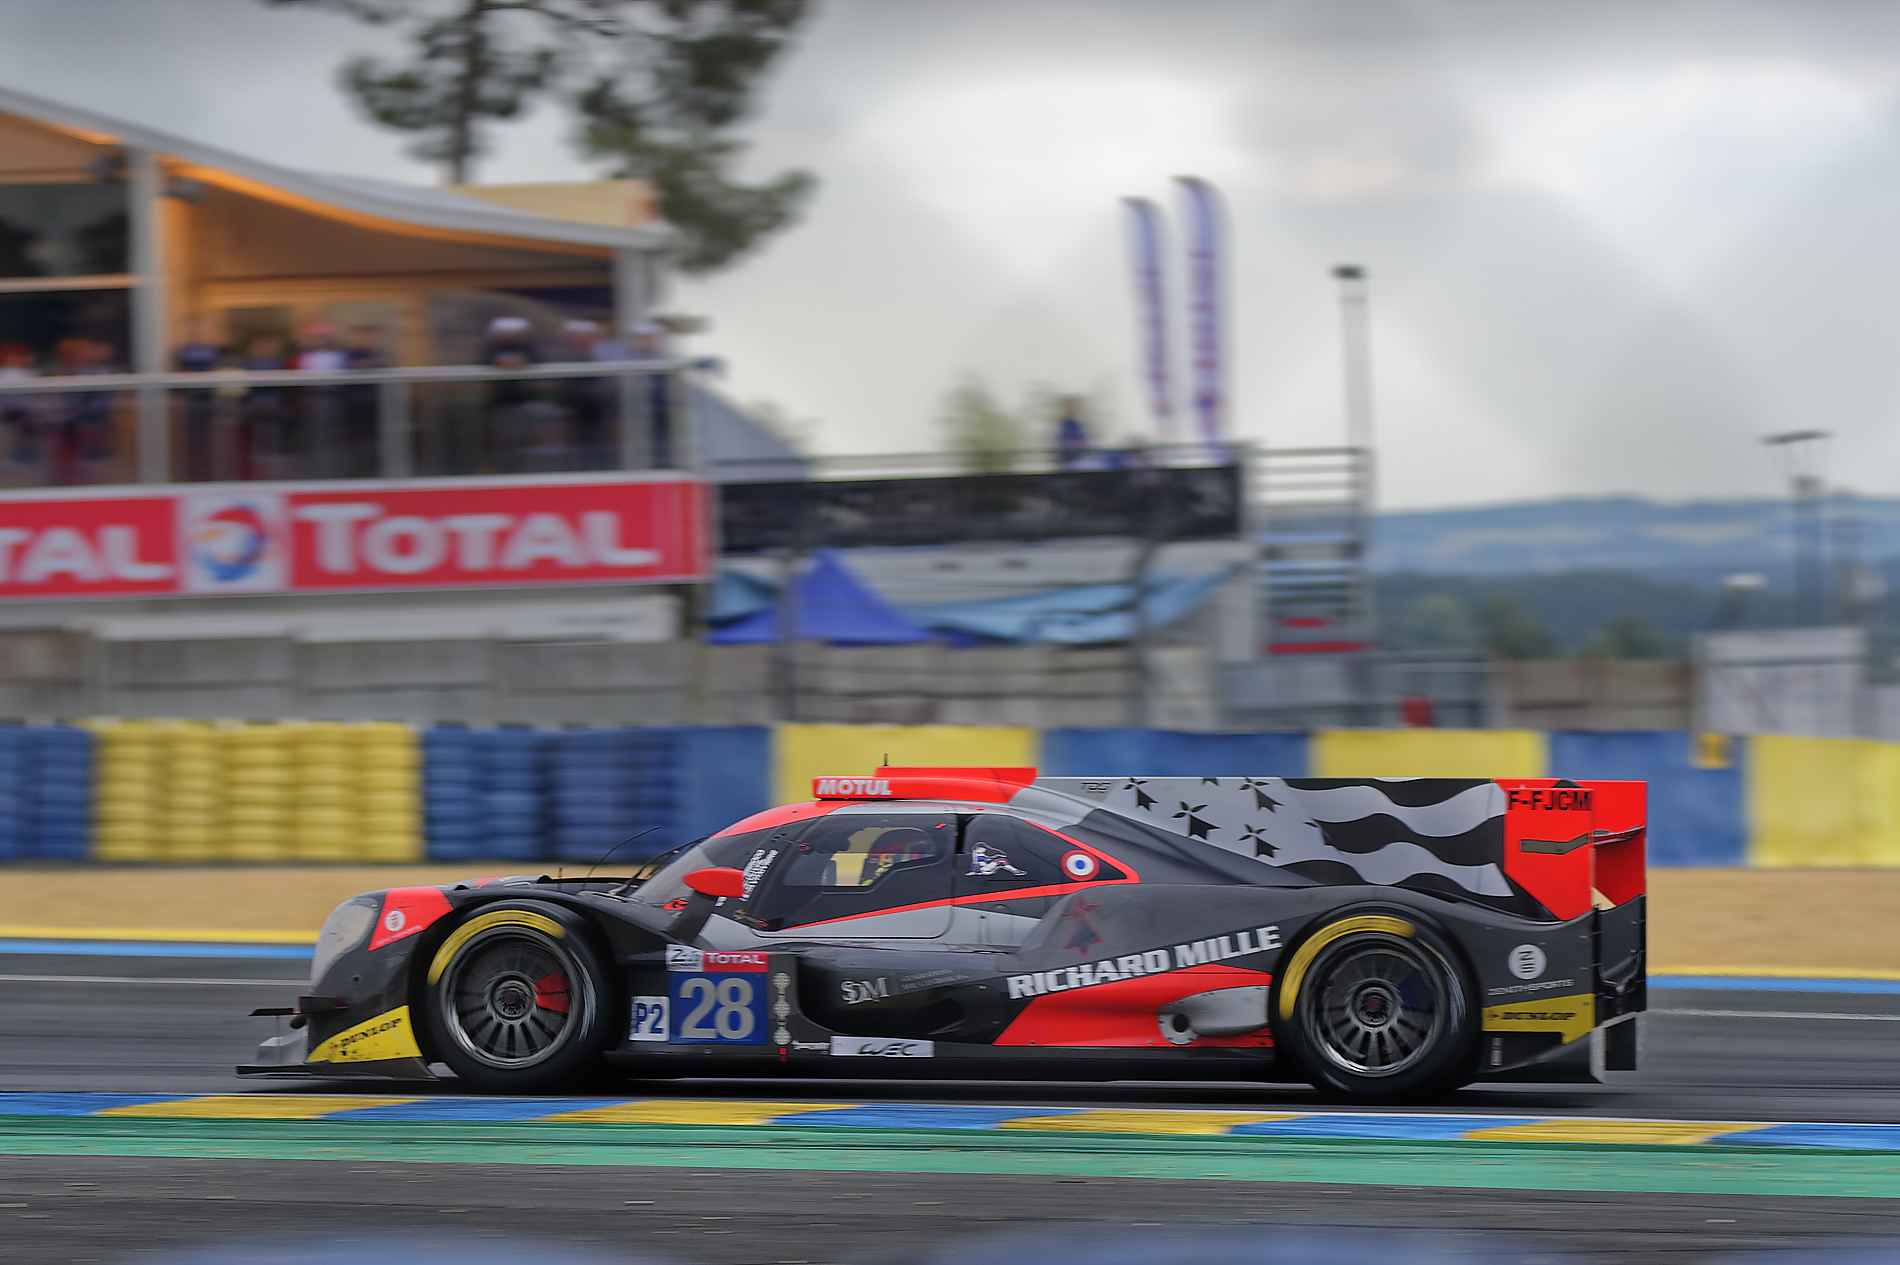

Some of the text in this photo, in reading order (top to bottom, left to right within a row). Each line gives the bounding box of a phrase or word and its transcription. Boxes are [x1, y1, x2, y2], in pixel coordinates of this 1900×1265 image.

[293, 503, 661, 573] TOTAL
[816, 780, 892, 795] MOTUL
[1507, 791, 1592, 811] F-FJCM
[705, 952, 766, 965] TOTAL
[1007, 950, 1170, 999] RICHARD
[1175, 926, 1282, 968] MILLE
[635, 1003, 664, 1034] P2
[680, 978, 754, 1040] 28
[340, 1018, 402, 1047] DUNLOP
[858, 1043, 918, 1056] WEC
